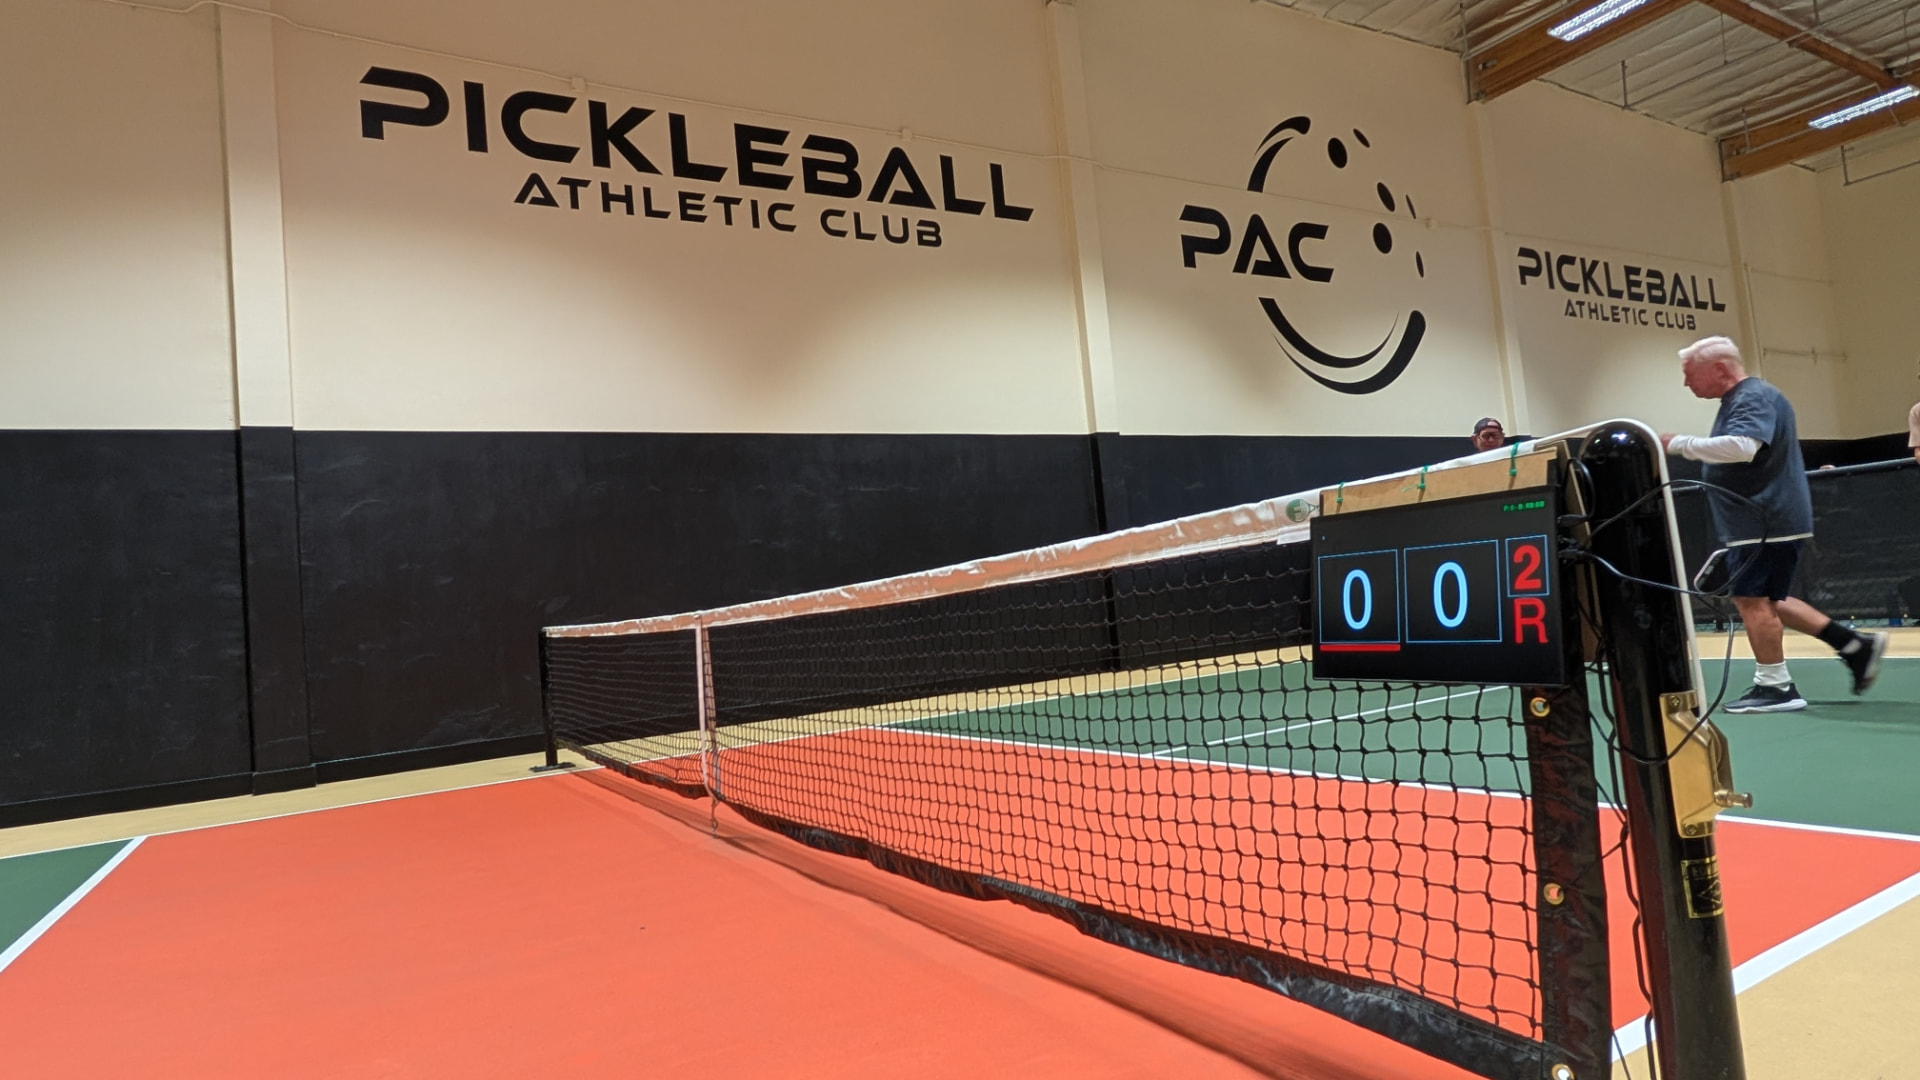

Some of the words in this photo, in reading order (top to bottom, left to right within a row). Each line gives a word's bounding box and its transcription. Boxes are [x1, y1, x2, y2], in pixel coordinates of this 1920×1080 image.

[359, 65, 1034, 222] PICKLEBALL
[513, 172, 798, 233] ATHLETIC
[820, 208, 943, 248] CLUB
[1179, 204, 1335, 283] PAC
[1517, 246, 1726, 313] PICKLEBALL
[1564, 298, 1649, 326] ATHLETIC
[1654, 310, 1697, 331] CLUB
[1342, 569, 1372, 630] 0
[1433, 561, 1468, 628] 0
[1513, 545, 1542, 590] 2
[1513, 598, 1548, 644] R
